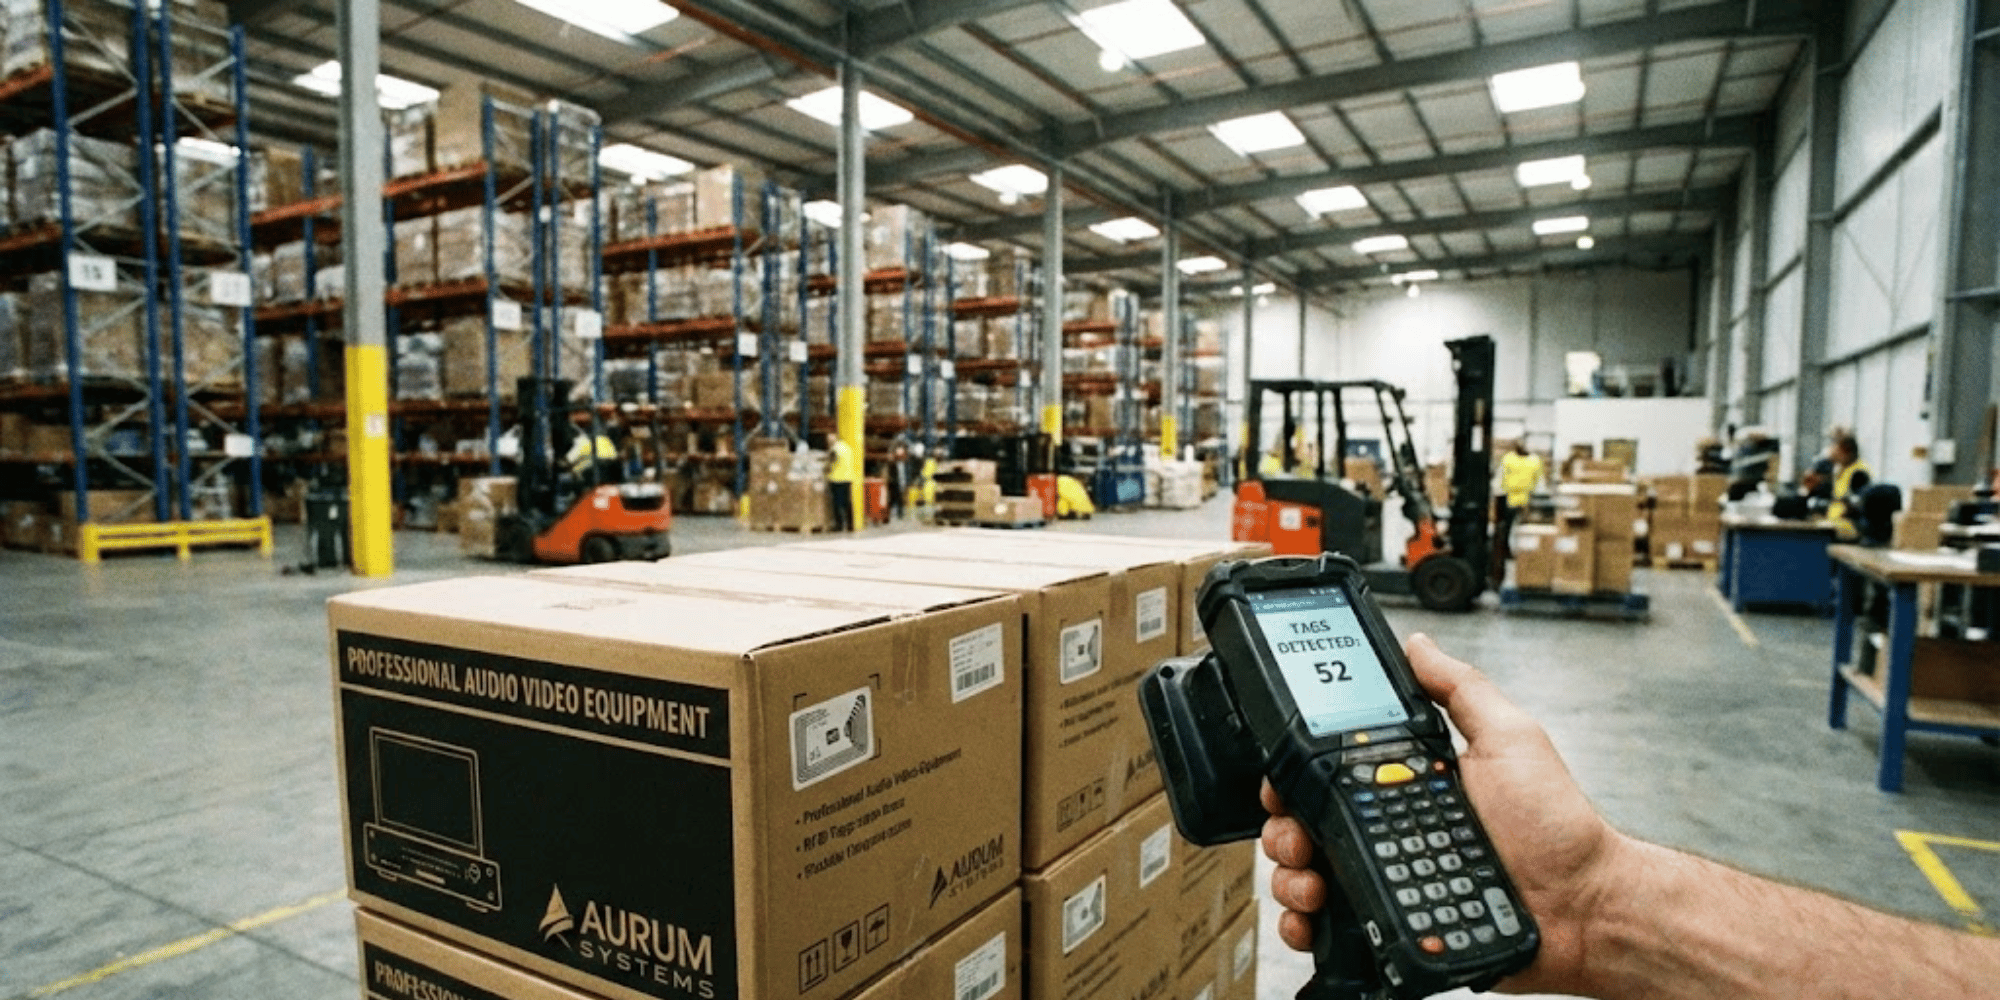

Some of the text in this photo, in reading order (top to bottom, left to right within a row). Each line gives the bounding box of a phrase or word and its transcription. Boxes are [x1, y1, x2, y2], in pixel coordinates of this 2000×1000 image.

[464, 666, 518, 702] AUDIO
[521, 676, 579, 715] VIDEO
[584, 686, 710, 739] EQUIPMENT
[1314, 660, 1353, 683] 52
[579, 940, 715, 999] SYSTEMS
[580, 899, 713, 976] AURUM
